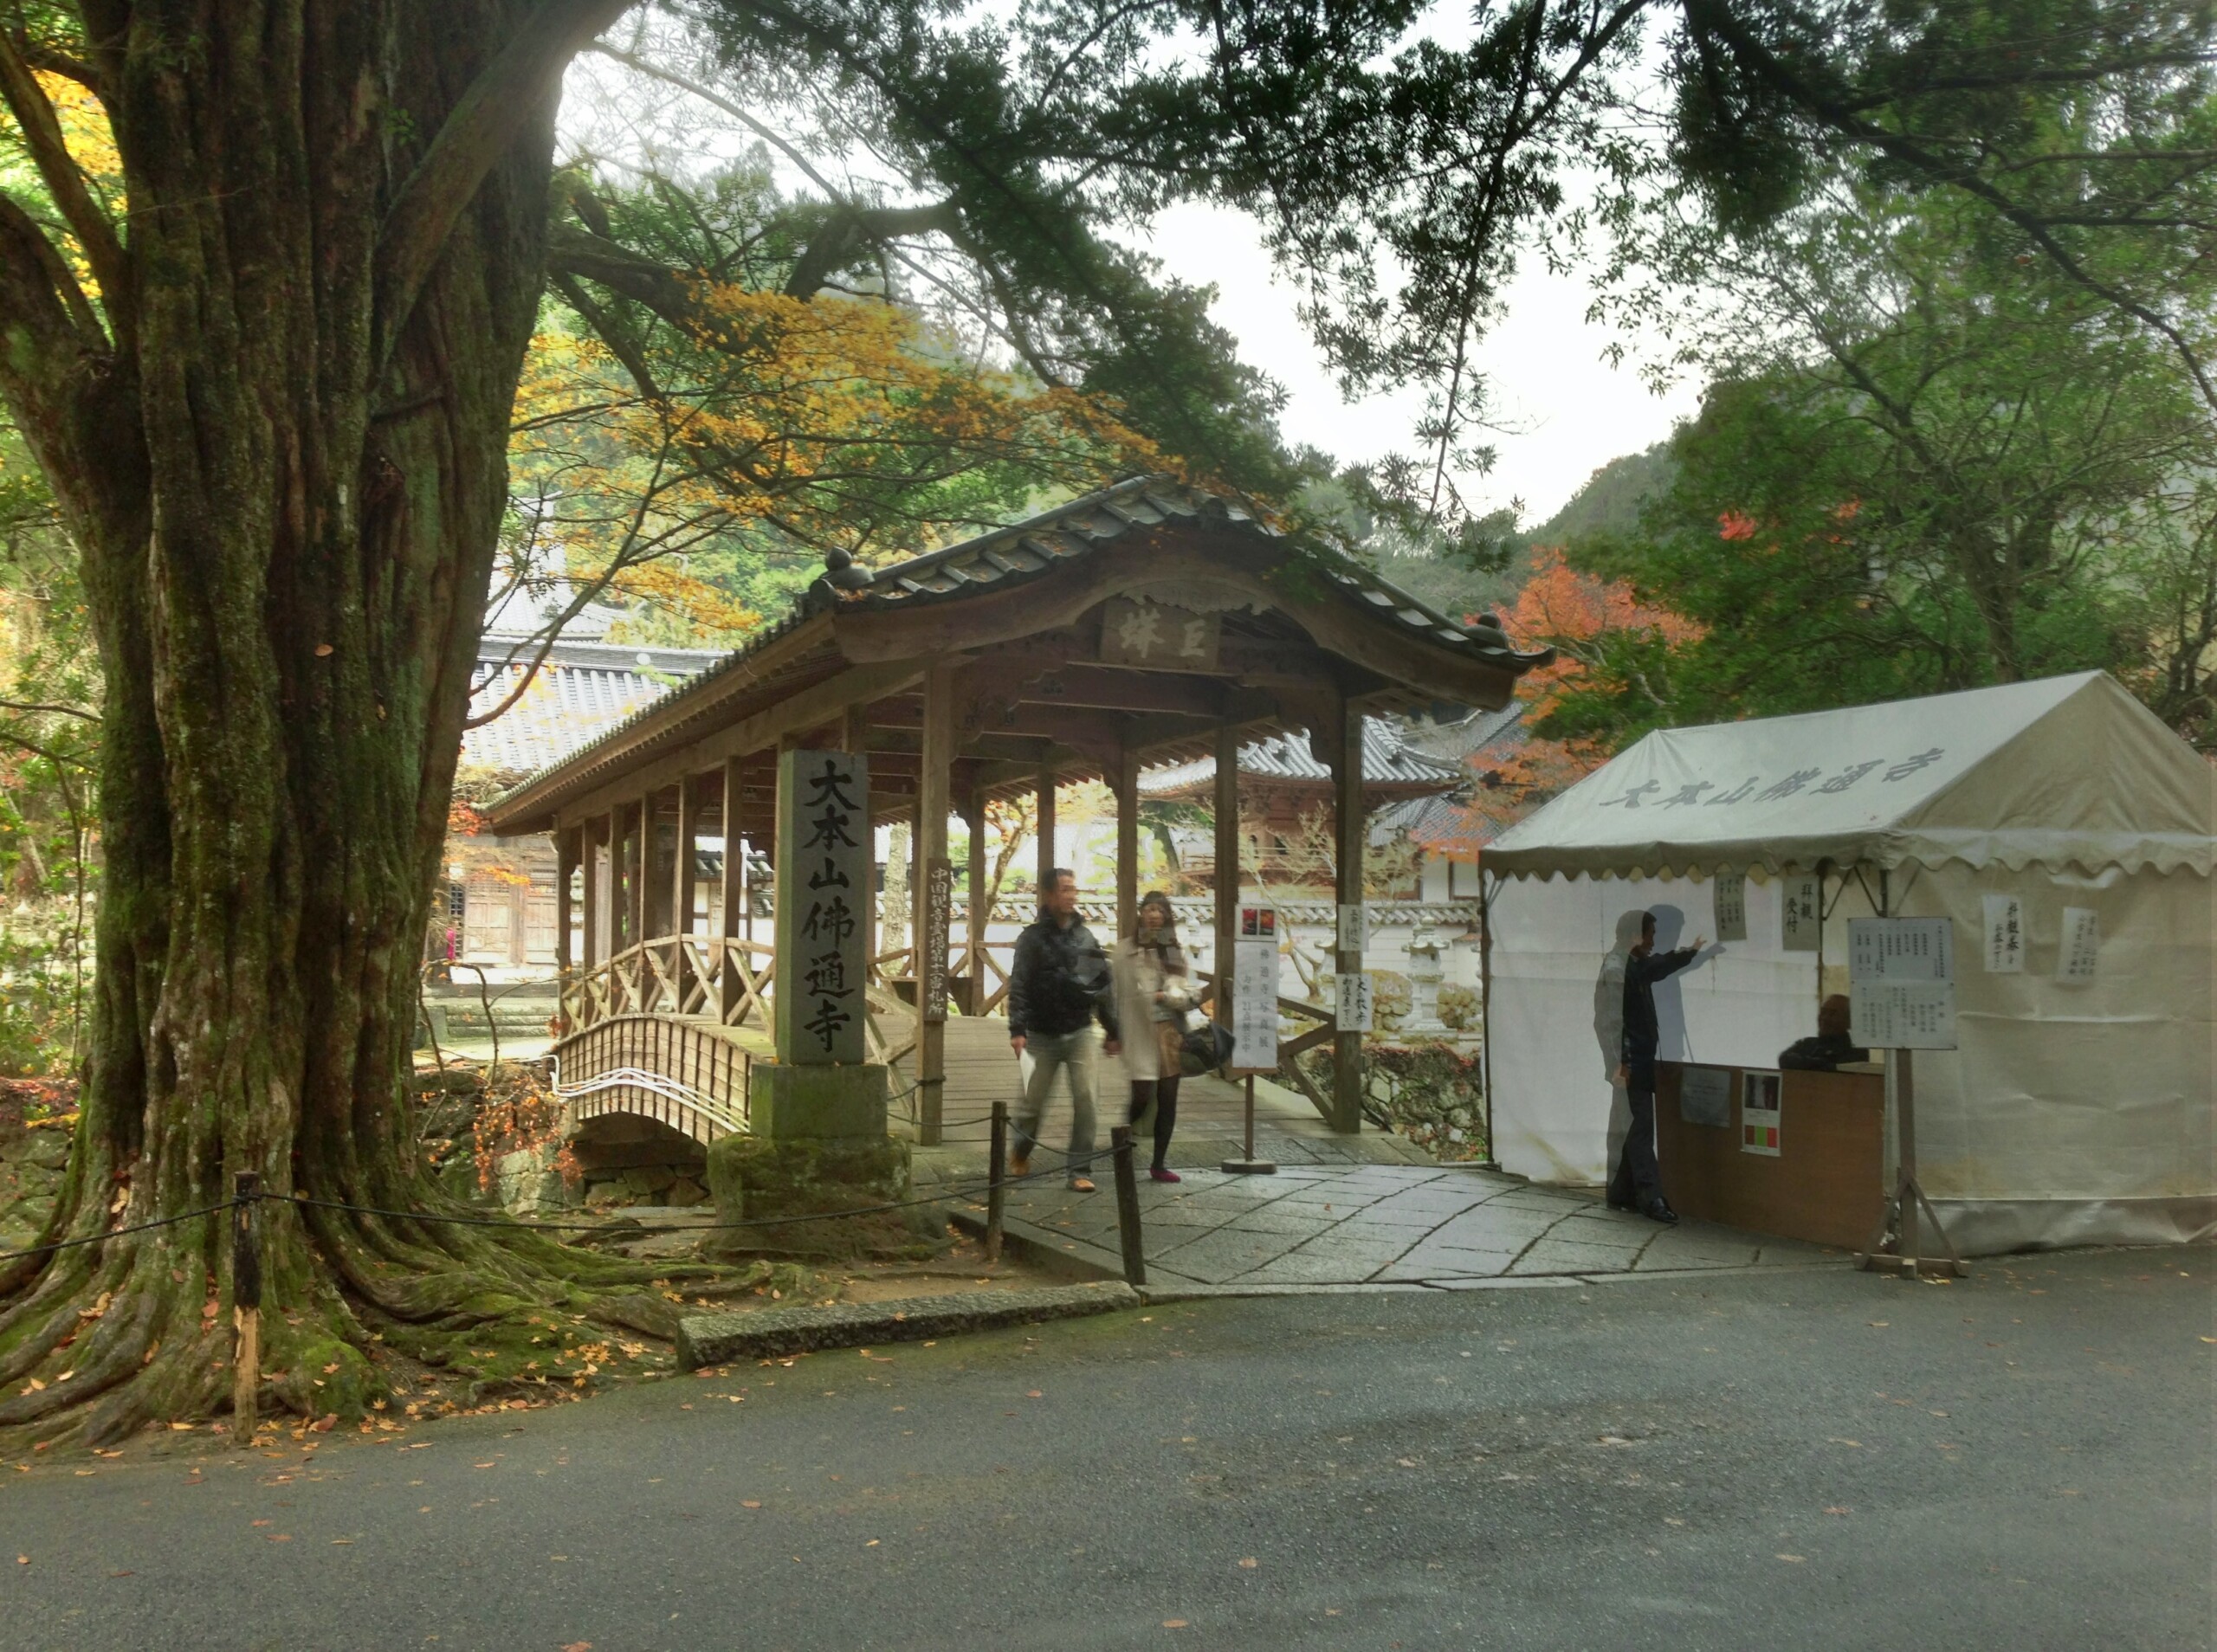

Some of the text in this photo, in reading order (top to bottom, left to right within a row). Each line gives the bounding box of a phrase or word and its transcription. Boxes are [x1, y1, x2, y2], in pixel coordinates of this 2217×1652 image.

[1599, 748, 1945, 810] 大本山佛通寺
[801, 759, 861, 1053] 大本山佛通寺
